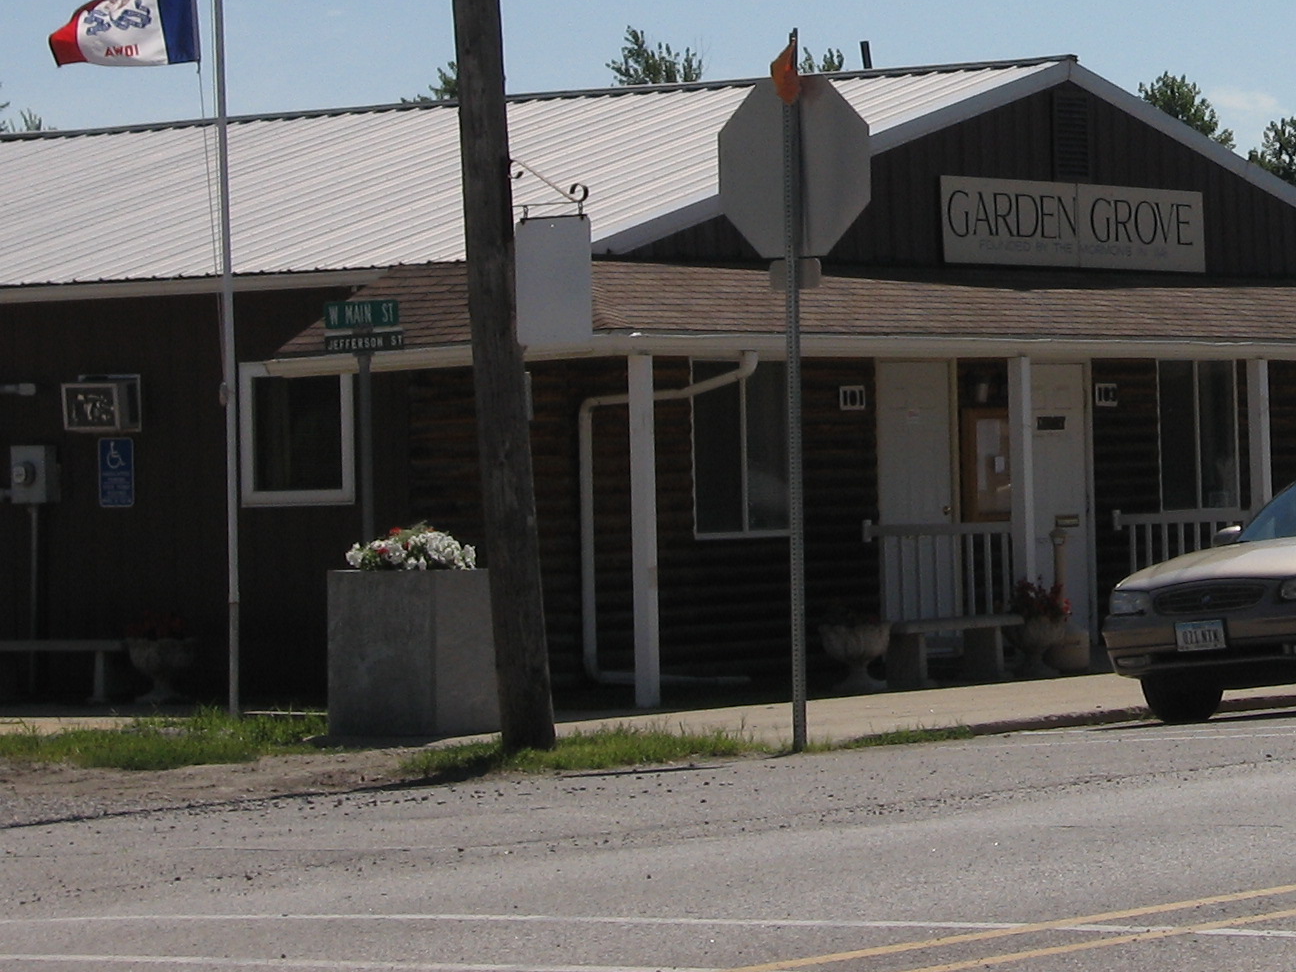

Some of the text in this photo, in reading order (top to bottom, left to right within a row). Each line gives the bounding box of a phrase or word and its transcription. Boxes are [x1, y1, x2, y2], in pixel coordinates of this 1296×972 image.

[947, 190, 1194, 246] GARDEN GROVE
[1053, 241, 1073, 254] THE
[328, 303, 394, 325] W MAIN ST
[327, 335, 403, 350] JEFFERSON ST
[843, 389, 864, 406] 101
